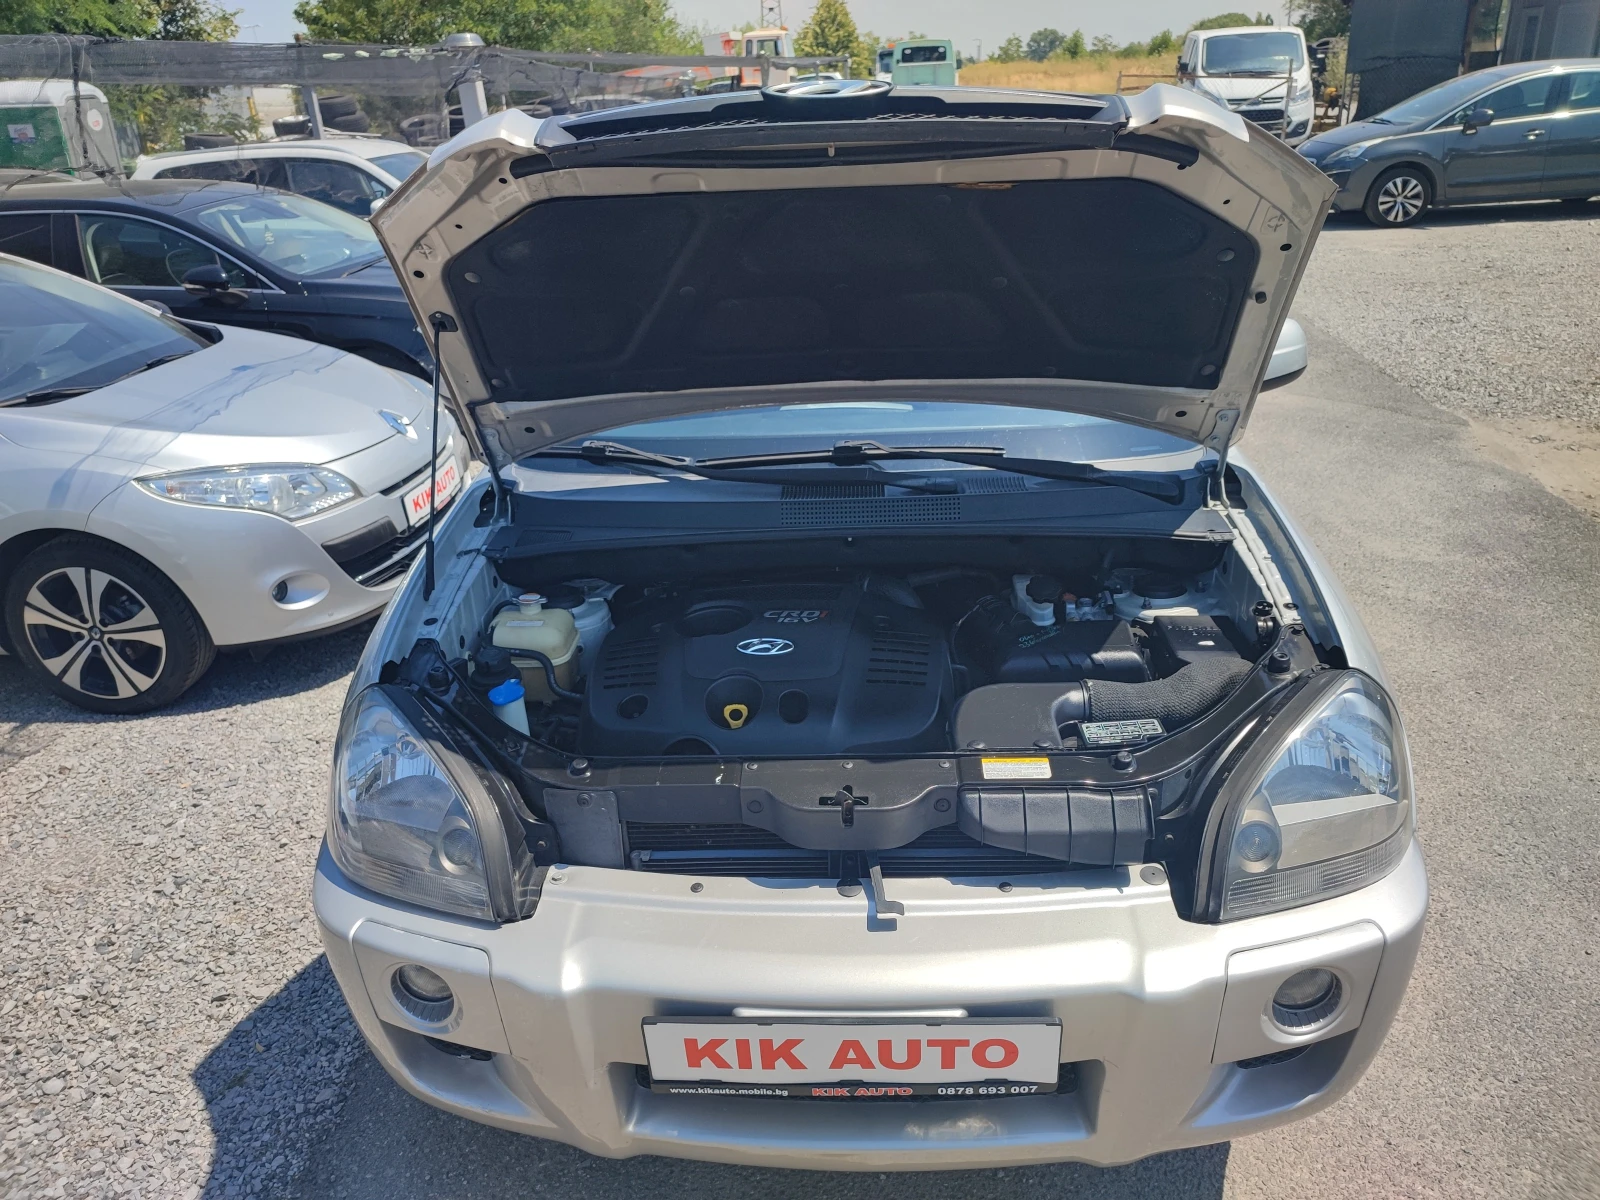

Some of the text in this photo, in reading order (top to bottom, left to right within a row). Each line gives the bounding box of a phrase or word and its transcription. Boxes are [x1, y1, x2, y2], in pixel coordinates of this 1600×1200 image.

[436, 466, 456, 496] AUTO
[683, 1037, 1019, 1070] KIK AUTO
[669, 1086, 789, 1097] www.kikauto.mobile.bg
[811, 1087, 913, 1097] KIK AUTO
[937, 1085, 1039, 1095] 0878 693 007
